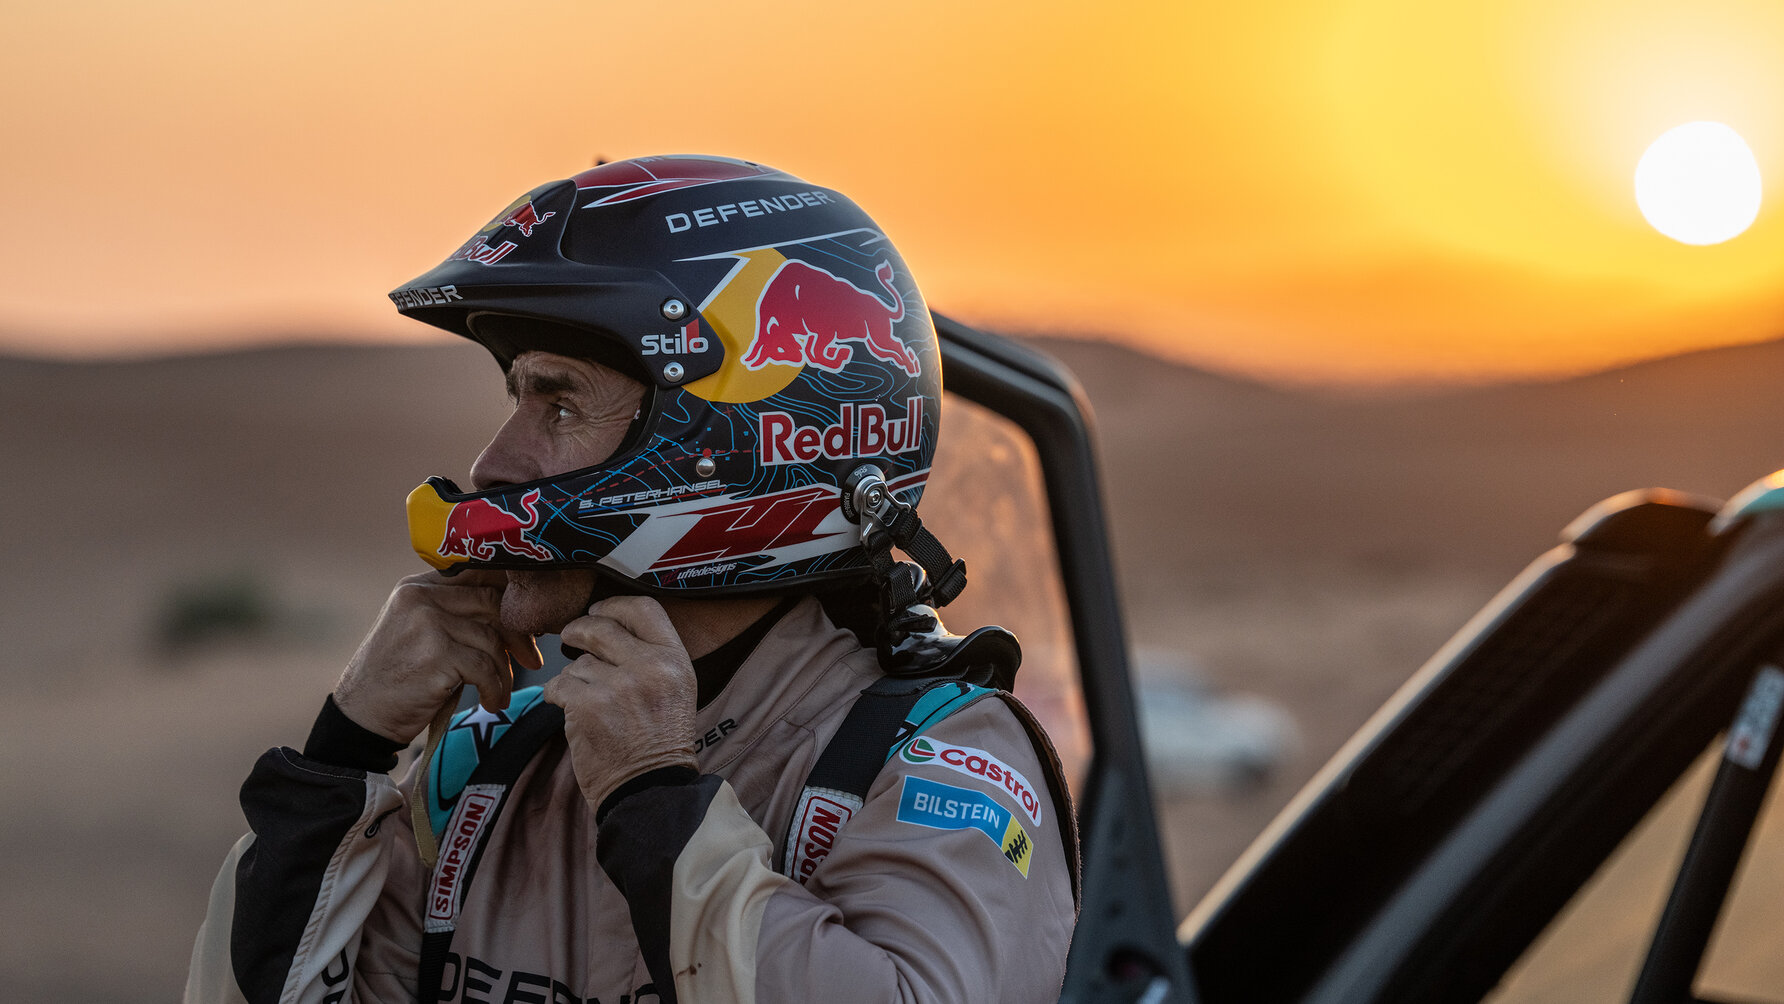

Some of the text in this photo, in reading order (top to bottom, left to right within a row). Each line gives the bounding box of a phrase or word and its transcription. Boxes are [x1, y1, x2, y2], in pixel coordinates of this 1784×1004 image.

[665, 191, 836, 234] DEFENDER
[641, 326, 709, 355] Stilo
[759, 395, 924, 466] Red Bull
[578, 479, 728, 510] S. PETERHANSEL
[913, 792, 1000, 828] BILSTEIN
[435, 802, 487, 912] SIMPSON
